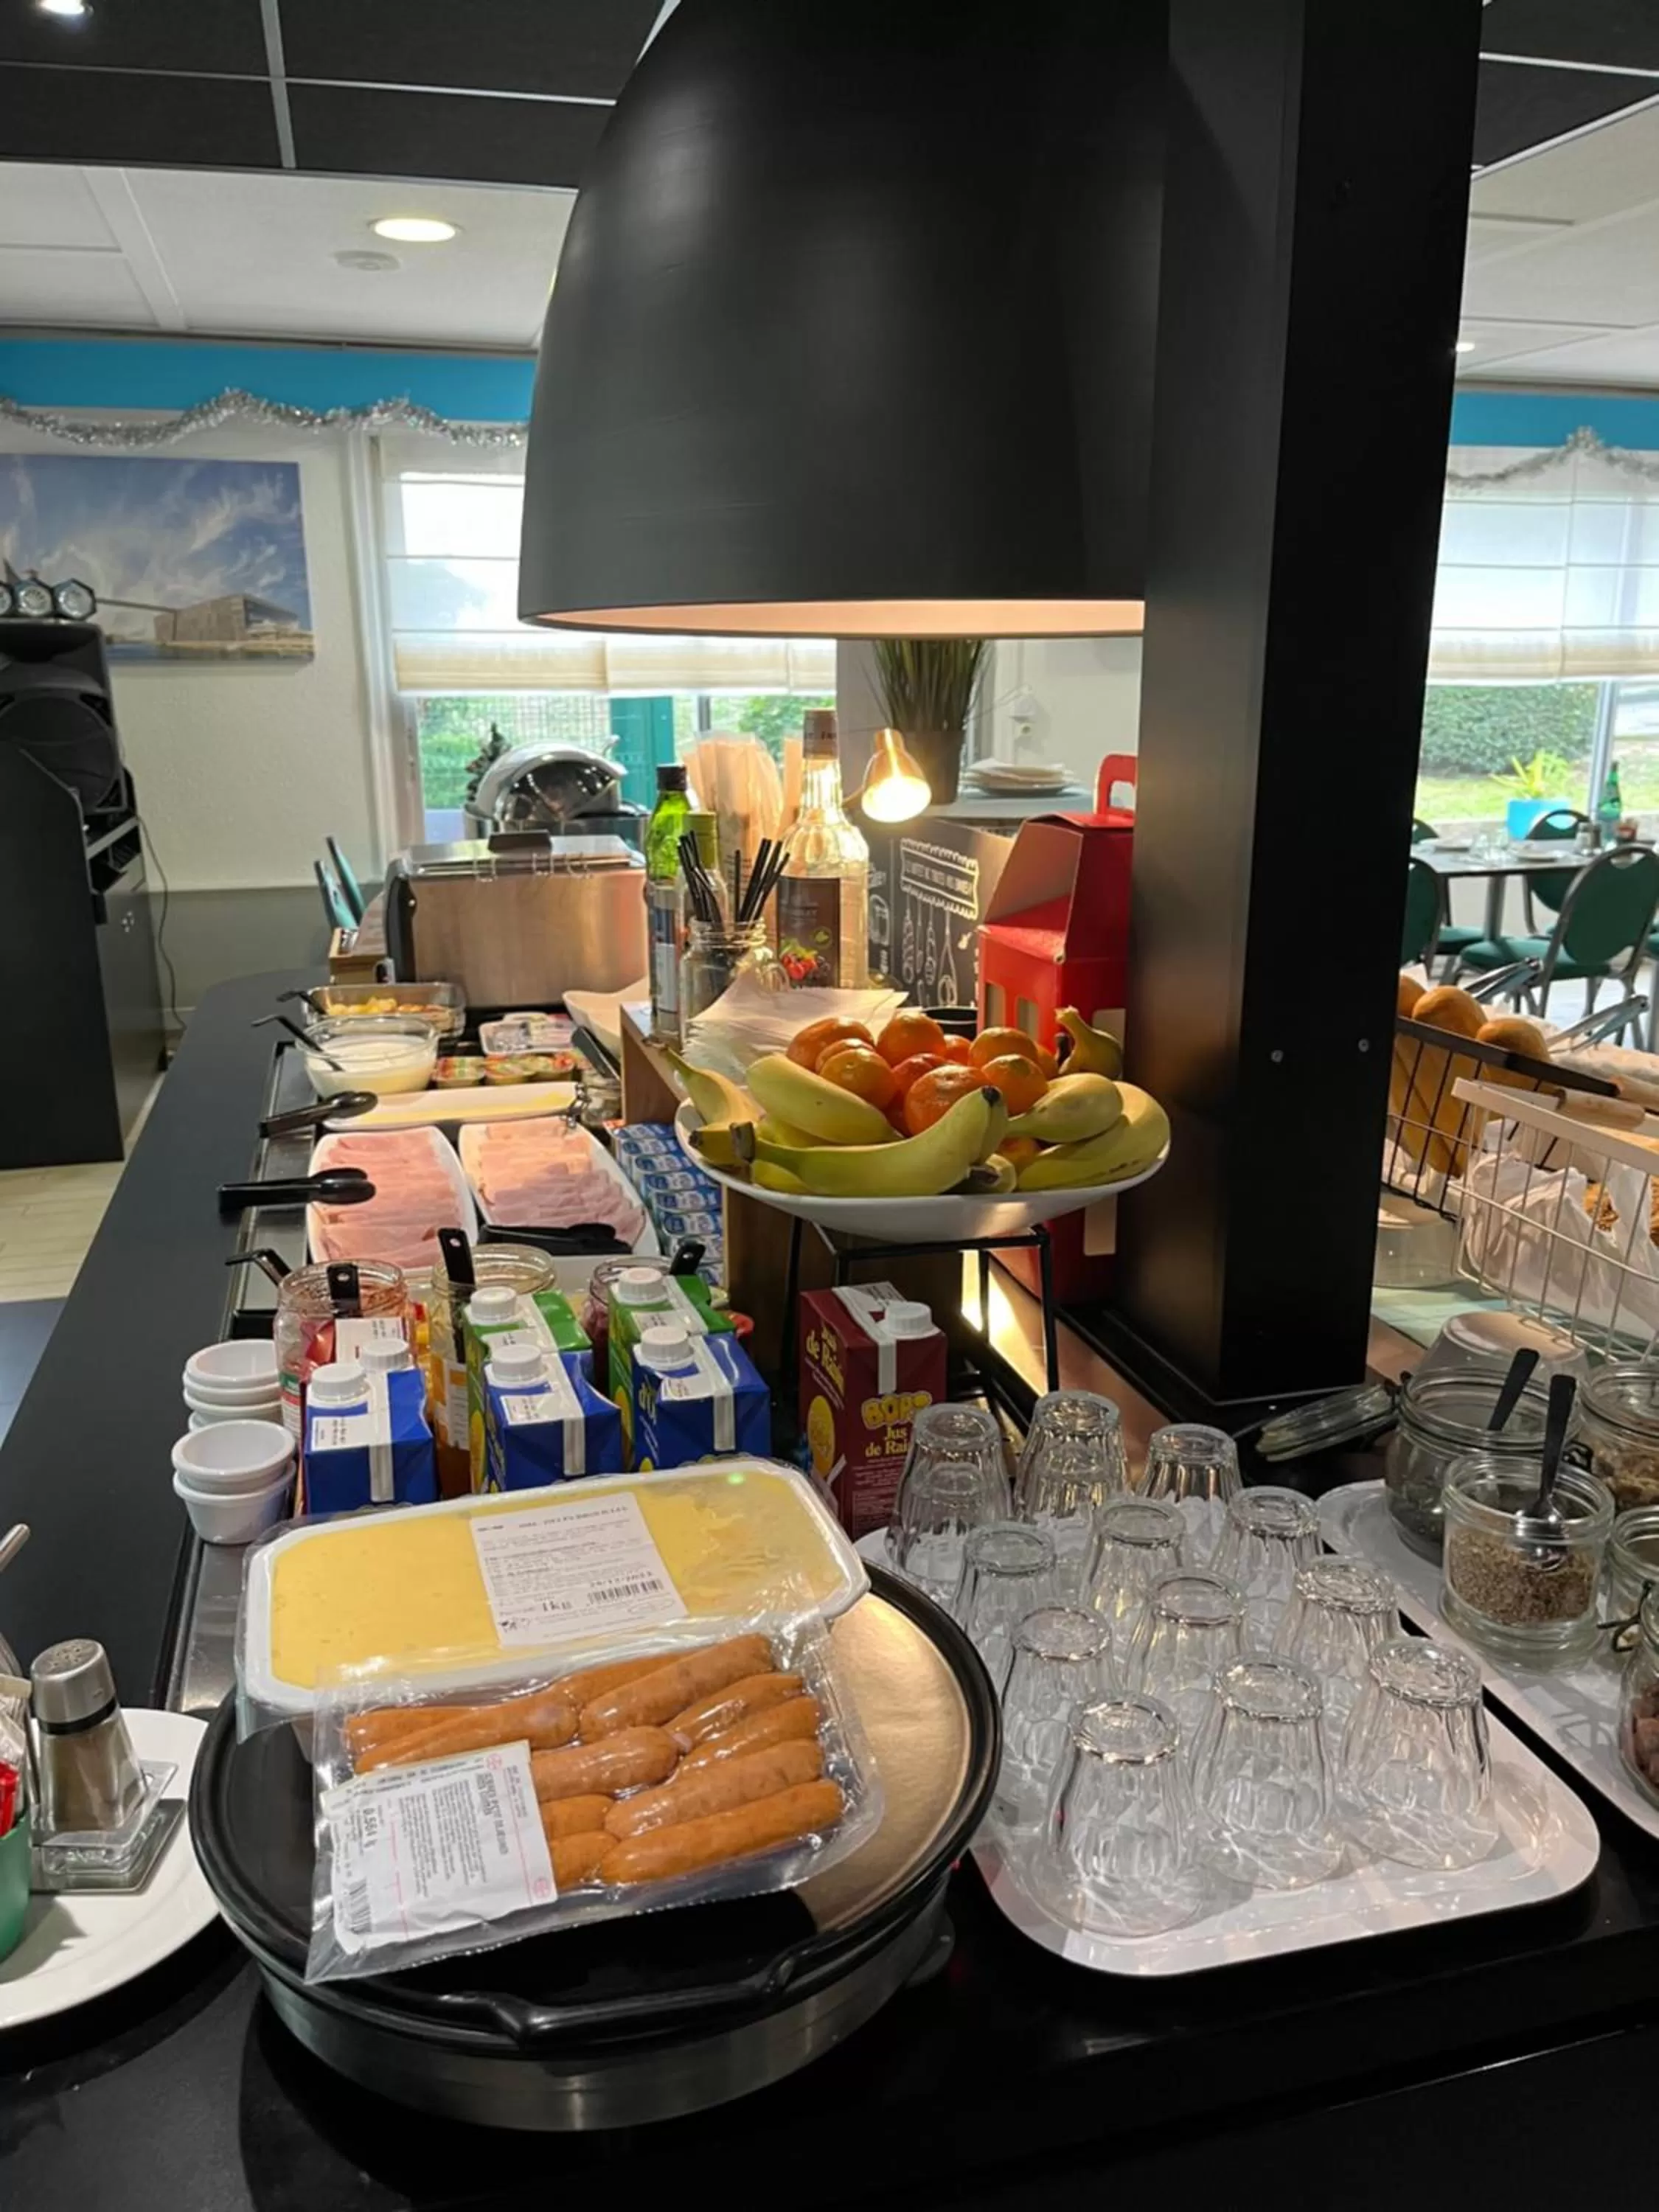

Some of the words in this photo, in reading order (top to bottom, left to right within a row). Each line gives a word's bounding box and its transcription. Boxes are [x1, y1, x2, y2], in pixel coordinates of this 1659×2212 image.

[884, 1425, 908, 1440] Jus
[865, 1442, 882, 1457] de
[886, 1439, 911, 1455] Rai
